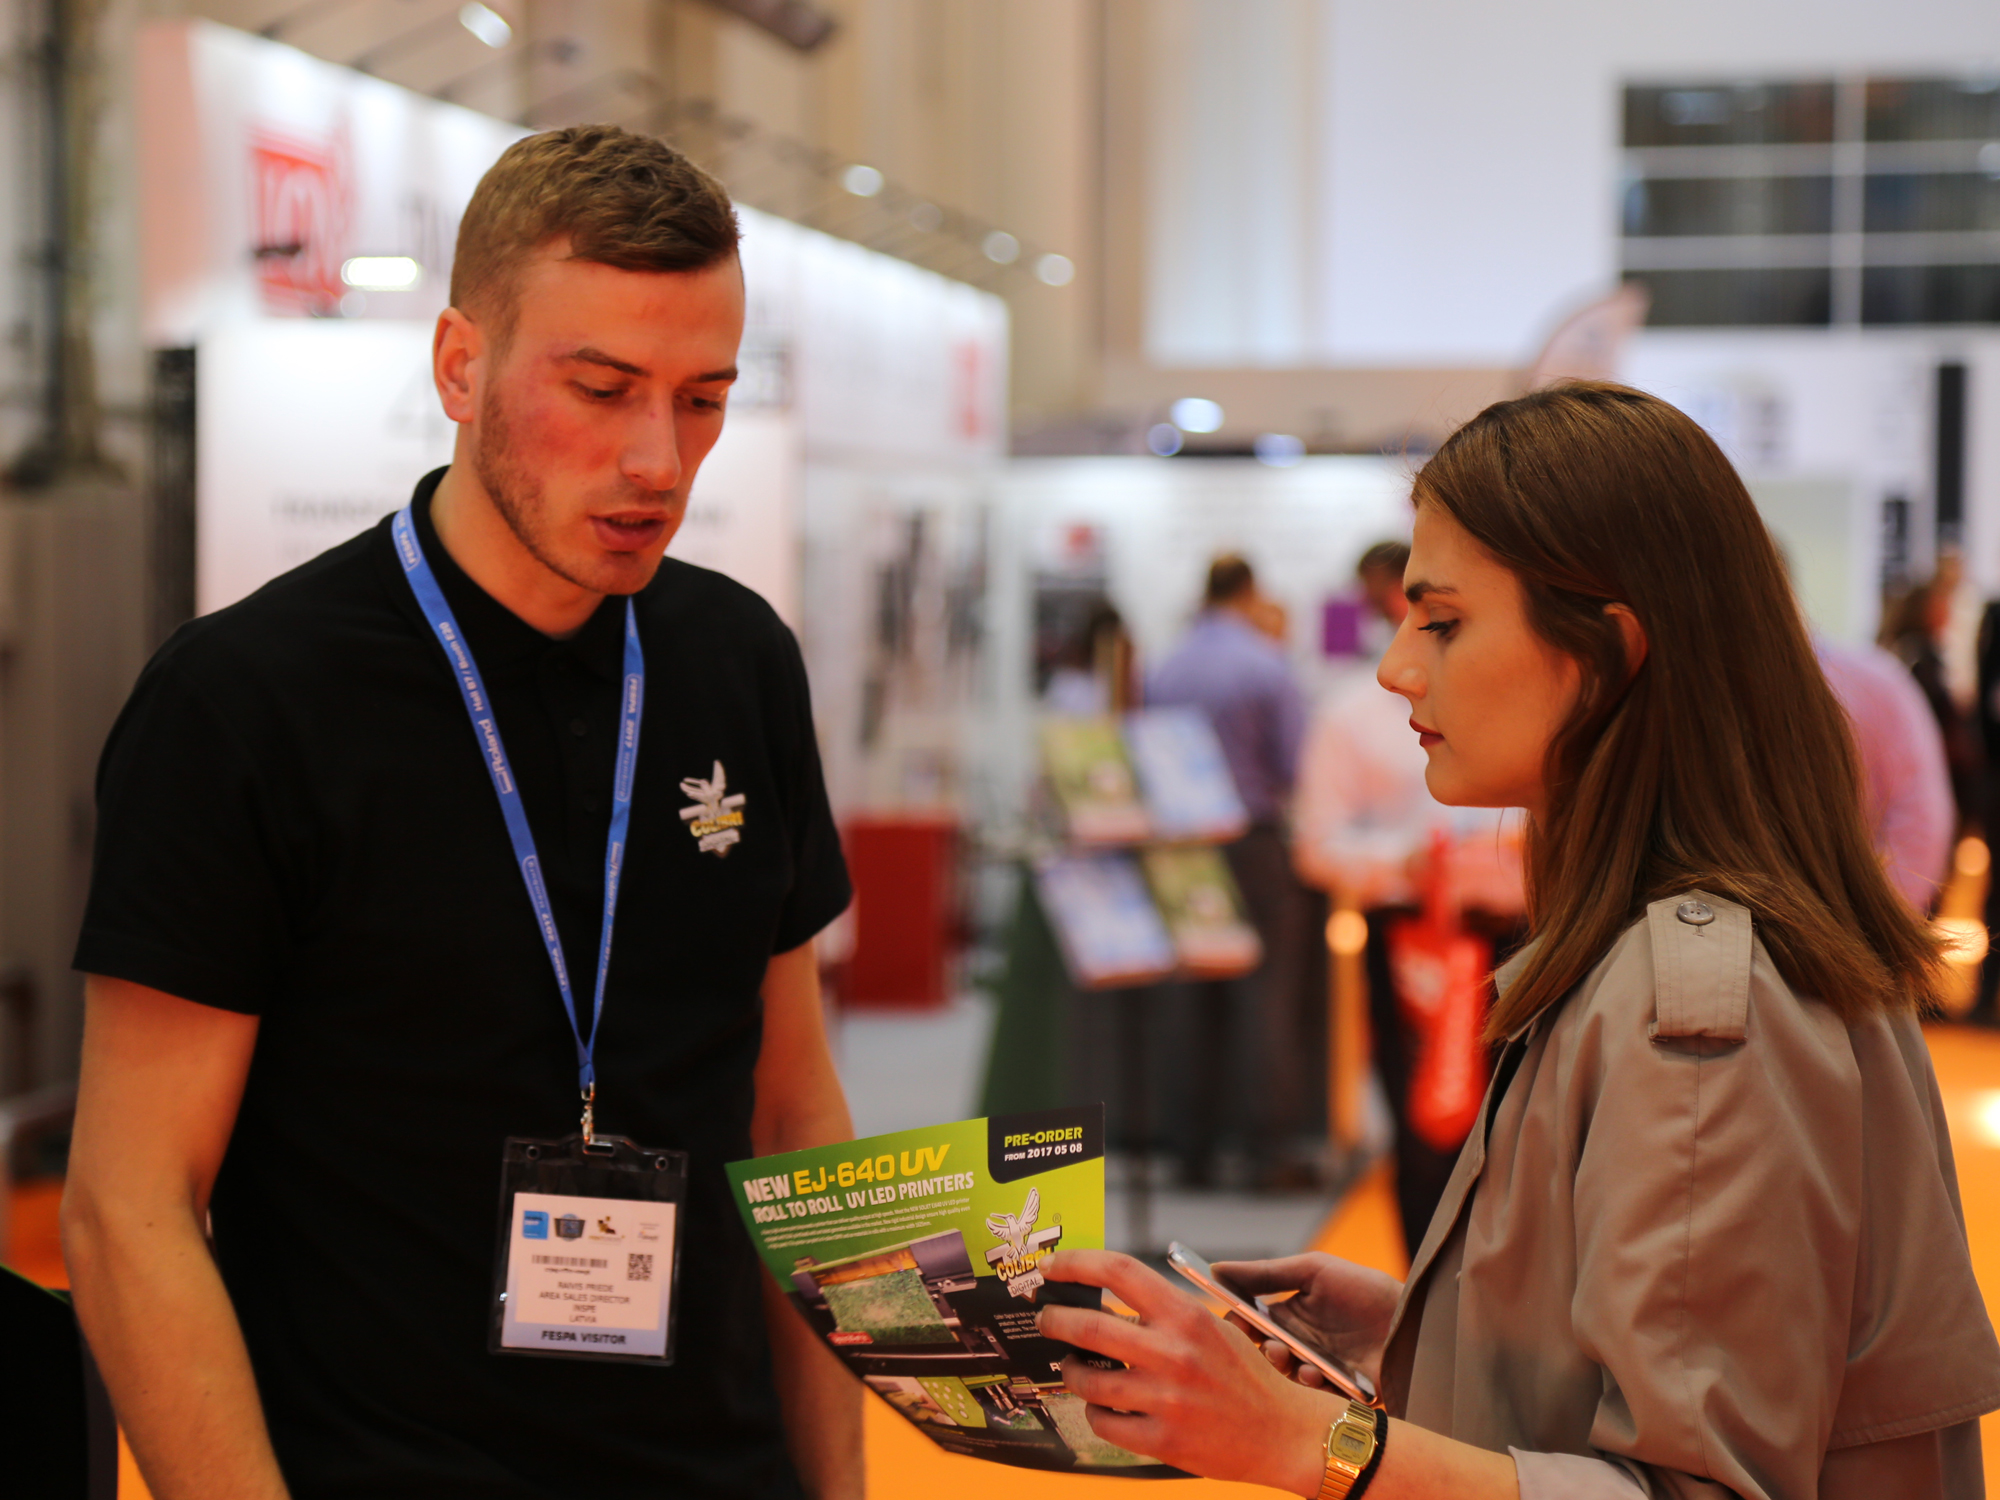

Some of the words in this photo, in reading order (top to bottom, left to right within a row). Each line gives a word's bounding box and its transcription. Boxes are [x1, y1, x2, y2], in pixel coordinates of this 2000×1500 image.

[438, 622, 456, 641] E20
[450, 641, 470, 669] Booth
[464, 676, 477, 690] B7
[469, 690, 485, 712] Hall
[627, 677, 638, 714] FESPA
[624, 719, 636, 748] 2017
[478, 718, 506, 773] Roland
[541, 913, 556, 942] 2017
[1004, 1127, 1083, 1148] PRE-ORDER
[1004, 1152, 1026, 1162] FROM
[1027, 1147, 1053, 1159] 2017
[1054, 1144, 1067, 1155] 05
[1069, 1143, 1083, 1153] 08
[743, 1173, 791, 1204] NEW
[793, 1154, 895, 1195] EJ-640
[900, 1144, 951, 1177] UV
[752, 1205, 789, 1224] ROLL
[786, 1201, 808, 1218] TO
[807, 1195, 843, 1215] ROLL
[846, 1190, 866, 1209] UV
[865, 1185, 897, 1205] LED
[898, 1171, 974, 1200] PRINTERS
[539, 1291, 560, 1299] AREA
[563, 1293, 587, 1301] SALES
[589, 1294, 630, 1304] DIRECTOR
[586, 1283, 614, 1292] PRIEDE
[1010, 1278, 1040, 1296] DIGITAL
[569, 1315, 597, 1323] LATVIA
[541, 1330, 577, 1342] FESPA
[580, 1332, 626, 1344] VISITOR
